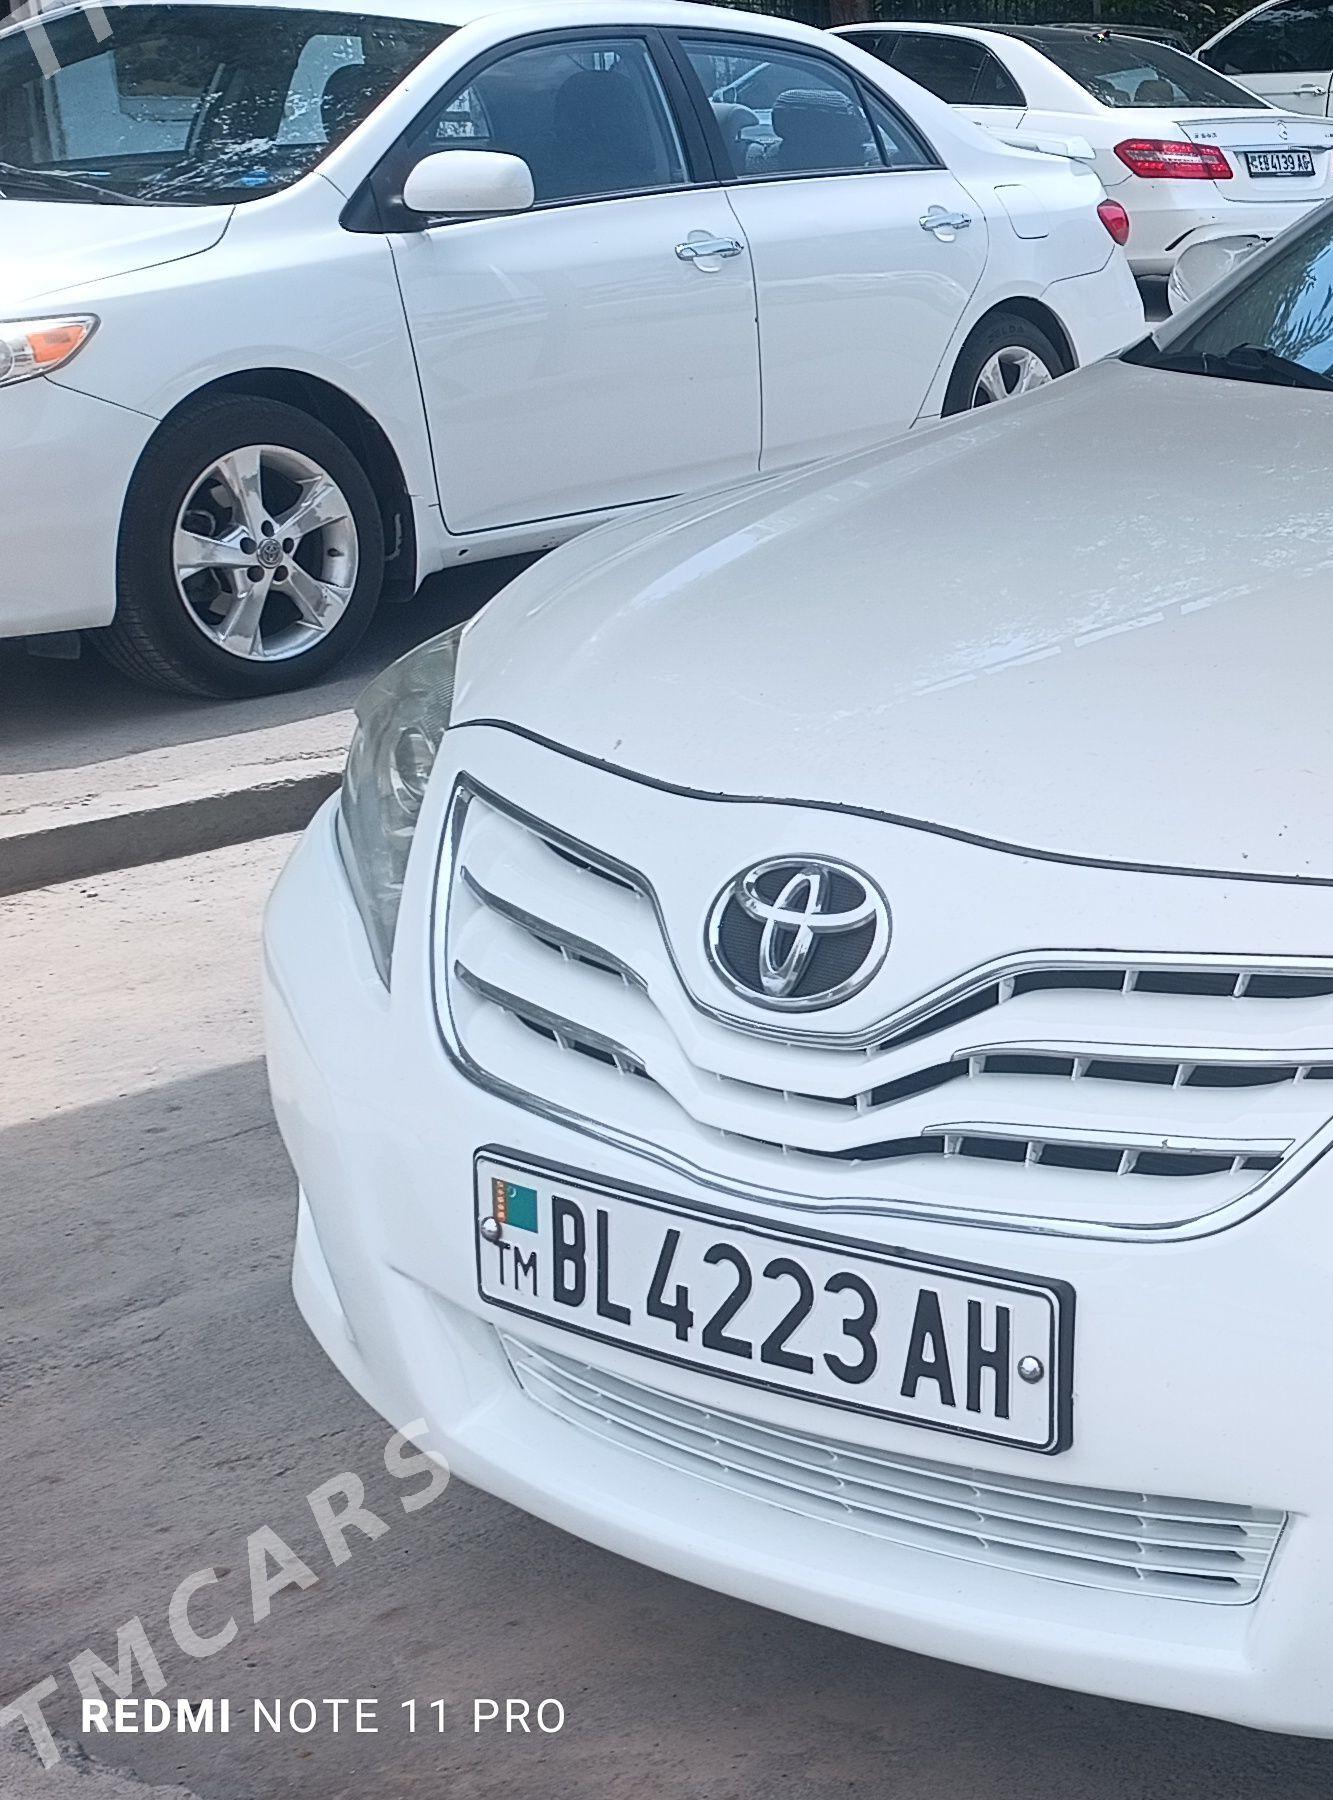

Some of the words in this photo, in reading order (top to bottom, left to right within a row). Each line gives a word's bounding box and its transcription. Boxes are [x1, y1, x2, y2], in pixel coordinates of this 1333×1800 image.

[494, 1239, 538, 1297] TM
[552, 1194, 632, 1326] BL
[646, 1227, 879, 1385] 4223
[900, 1288, 1010, 1420] AH
